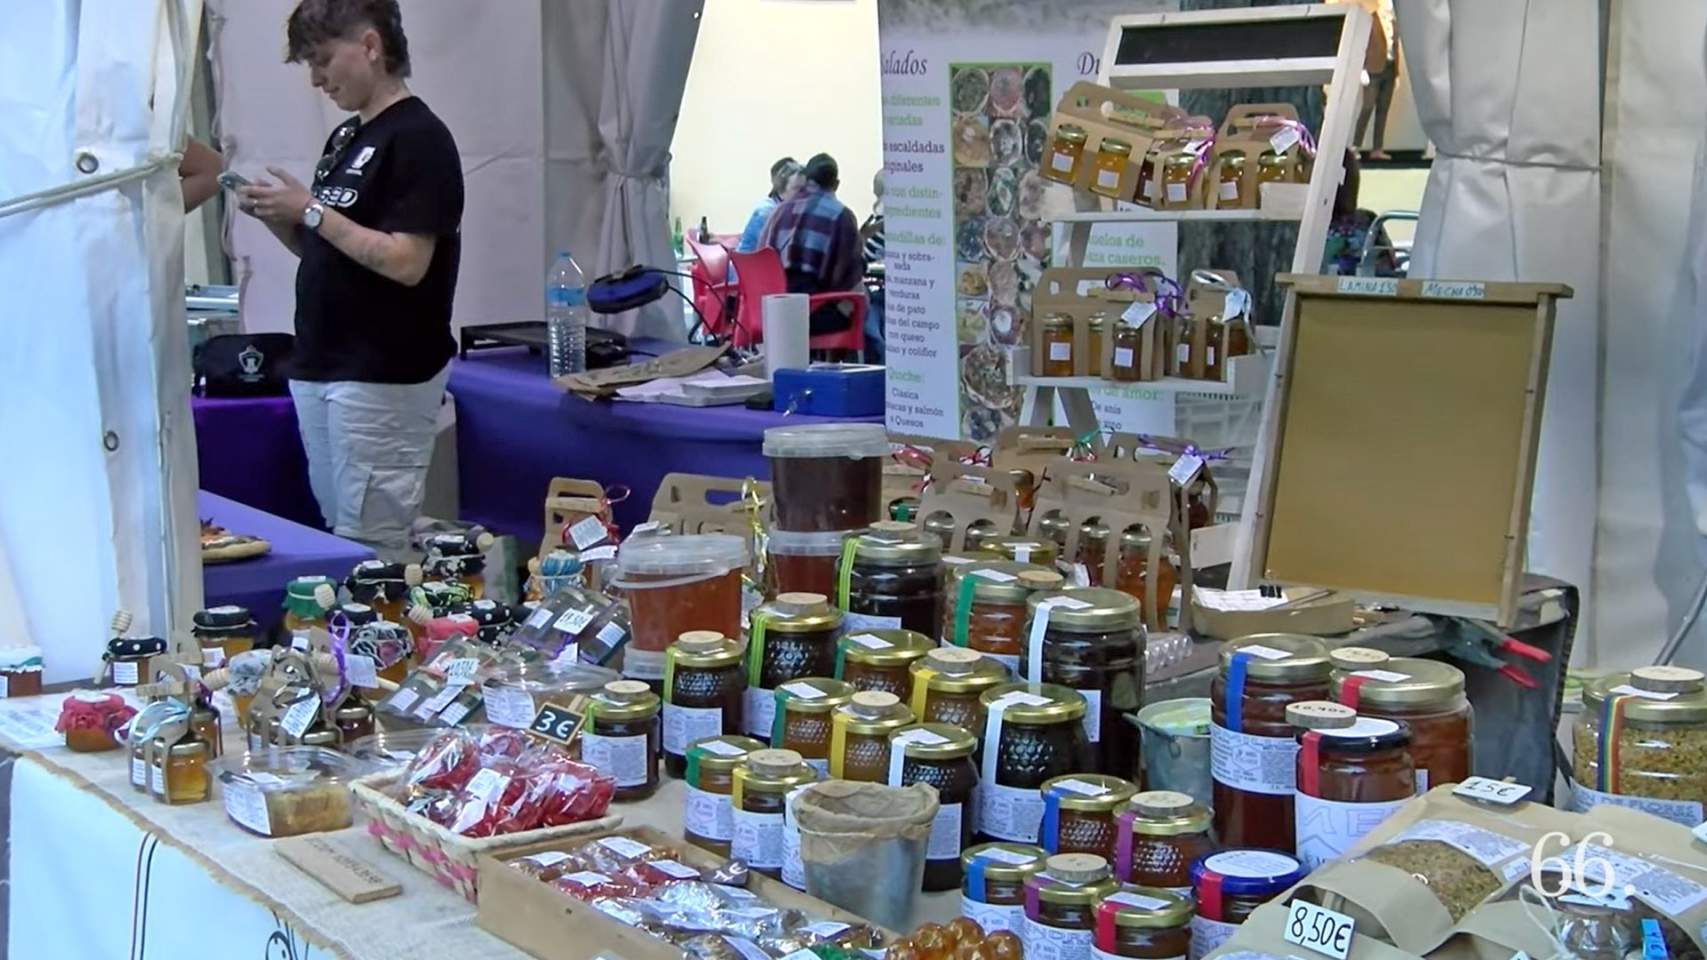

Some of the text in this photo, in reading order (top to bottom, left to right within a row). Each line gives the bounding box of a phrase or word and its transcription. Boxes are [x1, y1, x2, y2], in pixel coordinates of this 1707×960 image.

[536, 710, 575, 738] 3€
[714, 860, 749, 887] 1€
[1291, 905, 1352, 953] 8,50€
